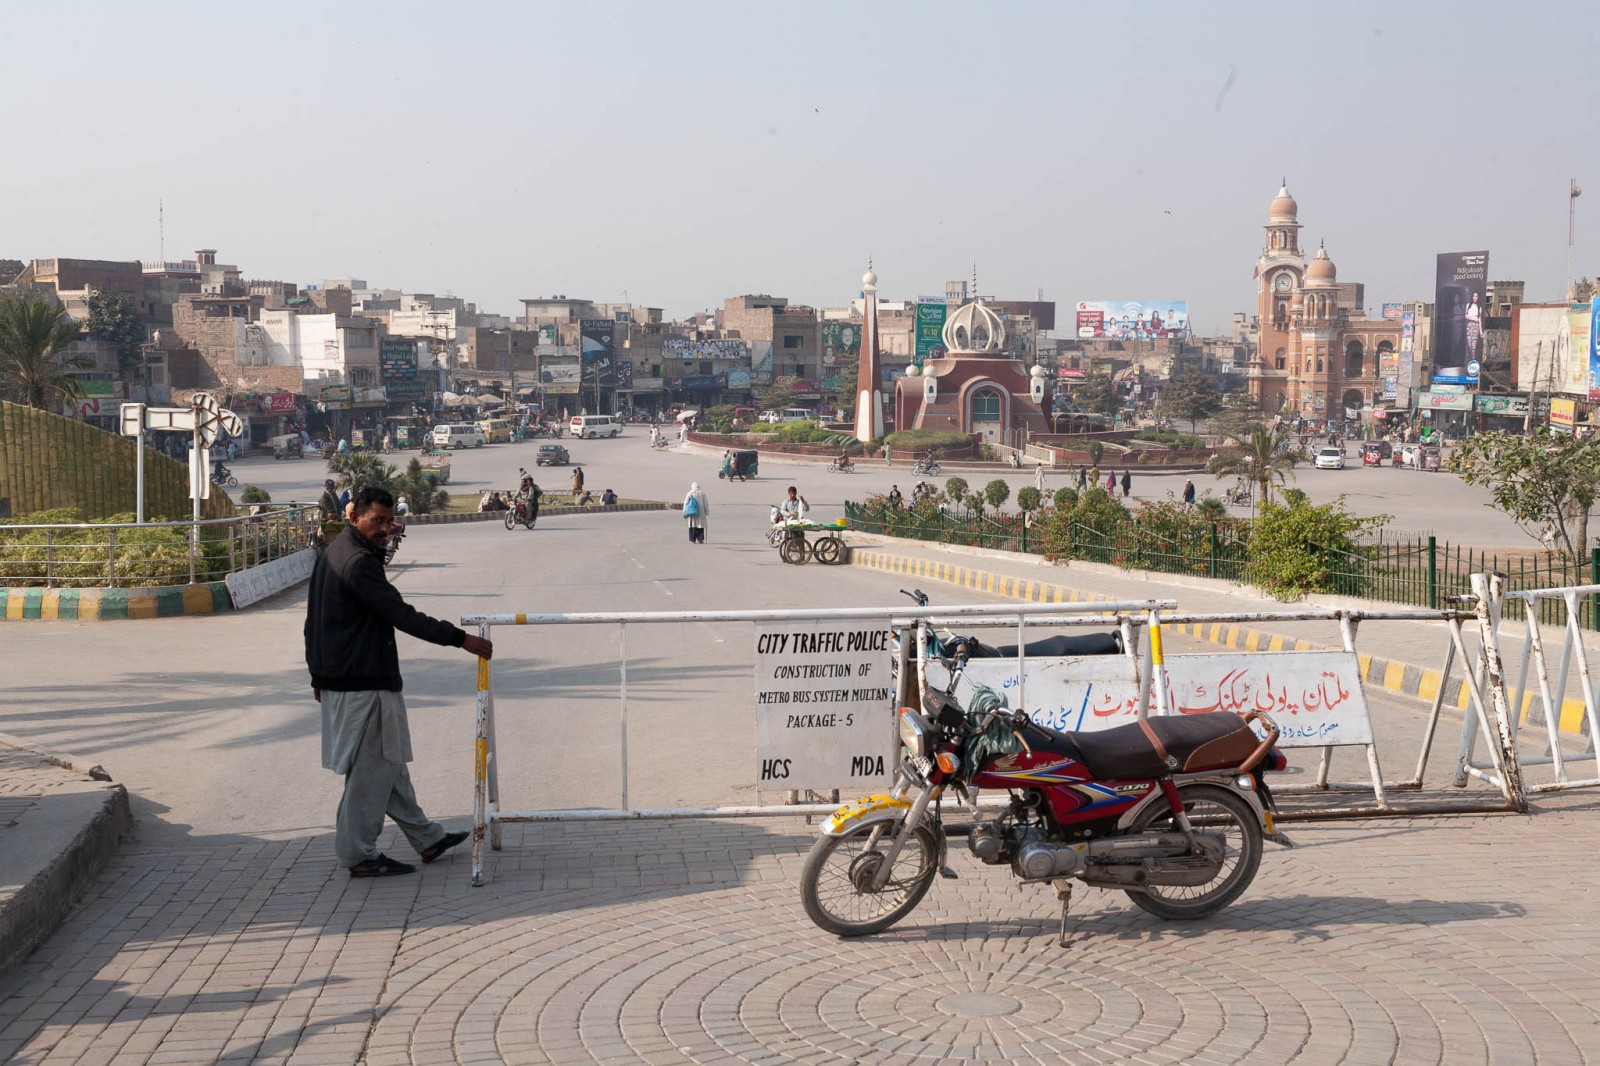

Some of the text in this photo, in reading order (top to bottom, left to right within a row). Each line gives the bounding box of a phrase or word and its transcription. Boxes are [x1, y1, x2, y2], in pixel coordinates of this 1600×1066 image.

[1453, 271, 1484, 281] good looking
[1456, 266, 1484, 276] Ridiculously
[757, 630, 889, 654] CITY TRAFFIC POLICE
[774, 663, 872, 679] CONSTRUCTION OF
[758, 688, 889, 704] METRO BUS SYSTEM MULTAN
[1256, 672, 1300, 716] پولی
[1302, 671, 1350, 712] ملتان
[1054, 706, 1072, 731] سٹی
[1282, 725, 1295, 738] روڈ
[1297, 725, 1318, 737] شاہ
[761, 758, 792, 780] HCS
[851, 756, 885, 777] MDA
[1113, 783, 1150, 792] CD70
